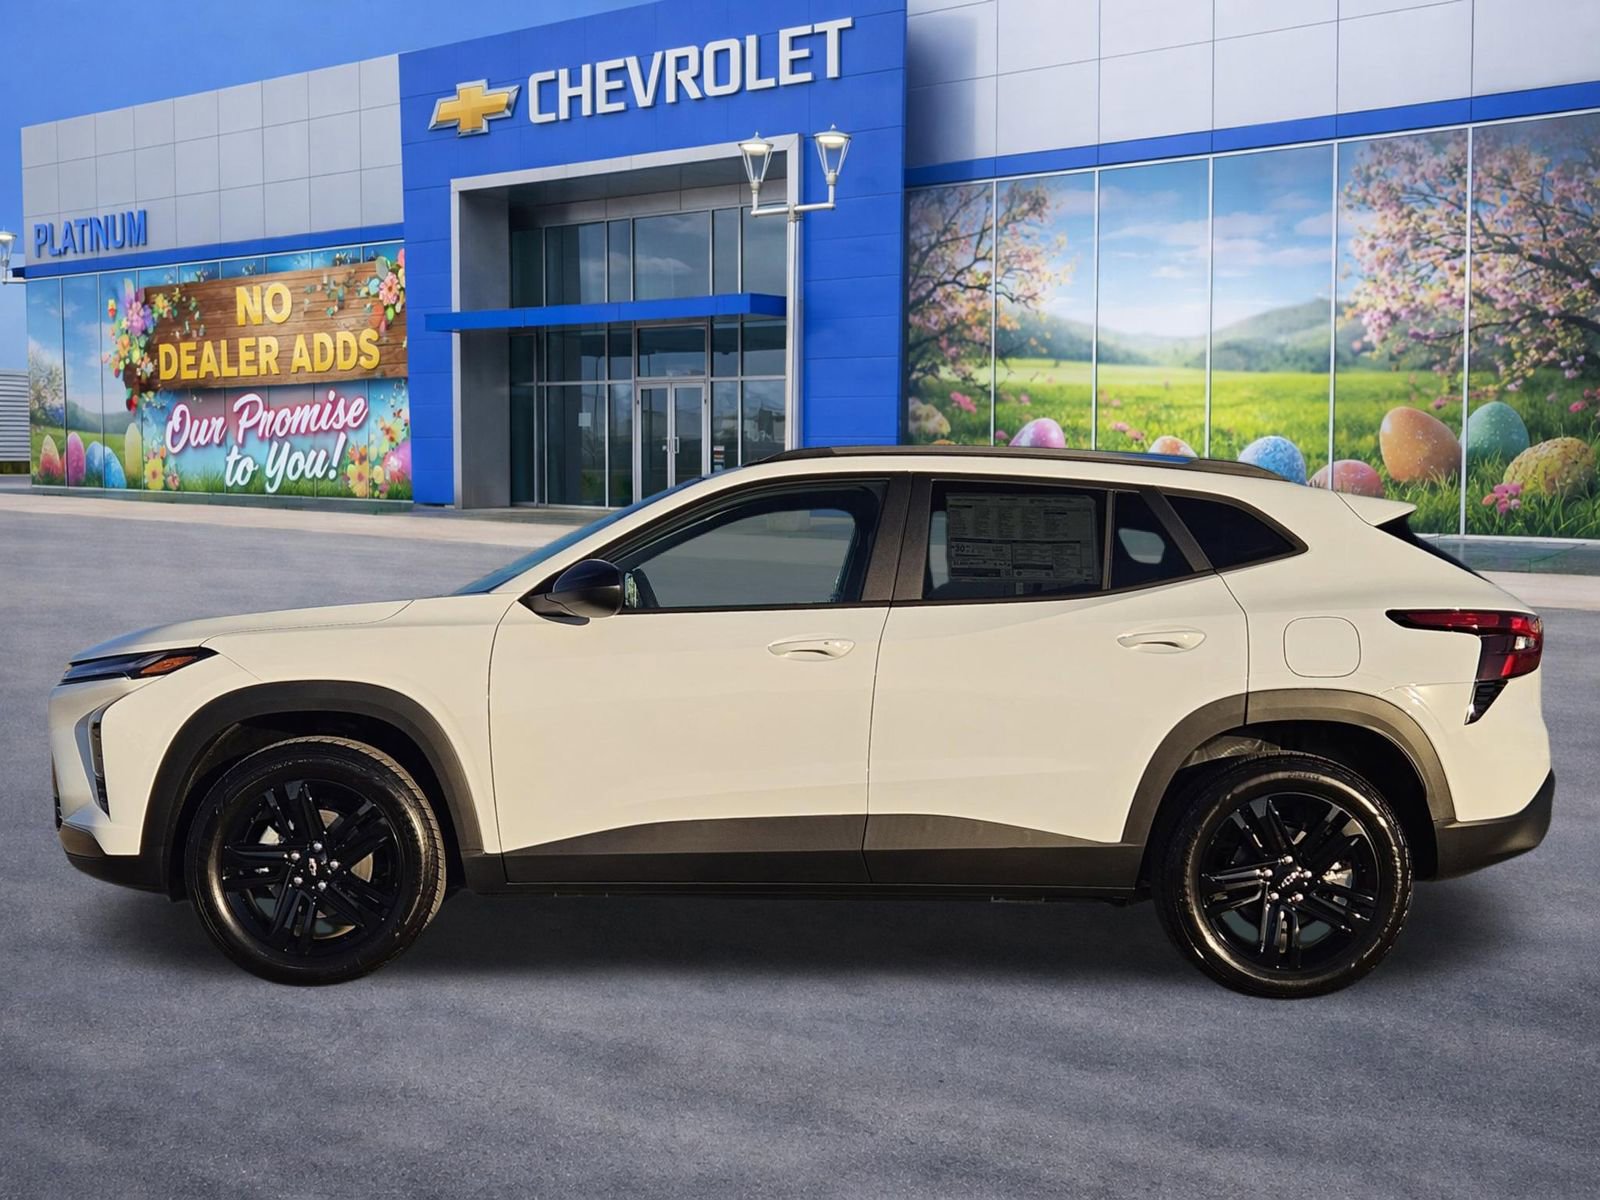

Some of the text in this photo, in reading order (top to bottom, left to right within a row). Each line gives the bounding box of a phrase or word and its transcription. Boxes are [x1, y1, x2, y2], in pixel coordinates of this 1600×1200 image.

[528, 17, 853, 124] CHEVROLET
[34, 210, 147, 257] PLATINUM
[235, 282, 292, 326] NO
[158, 328, 381, 380] DEALER ADDS
[165, 391, 368, 453] Our Promise
[224, 433, 347, 494] to You!
